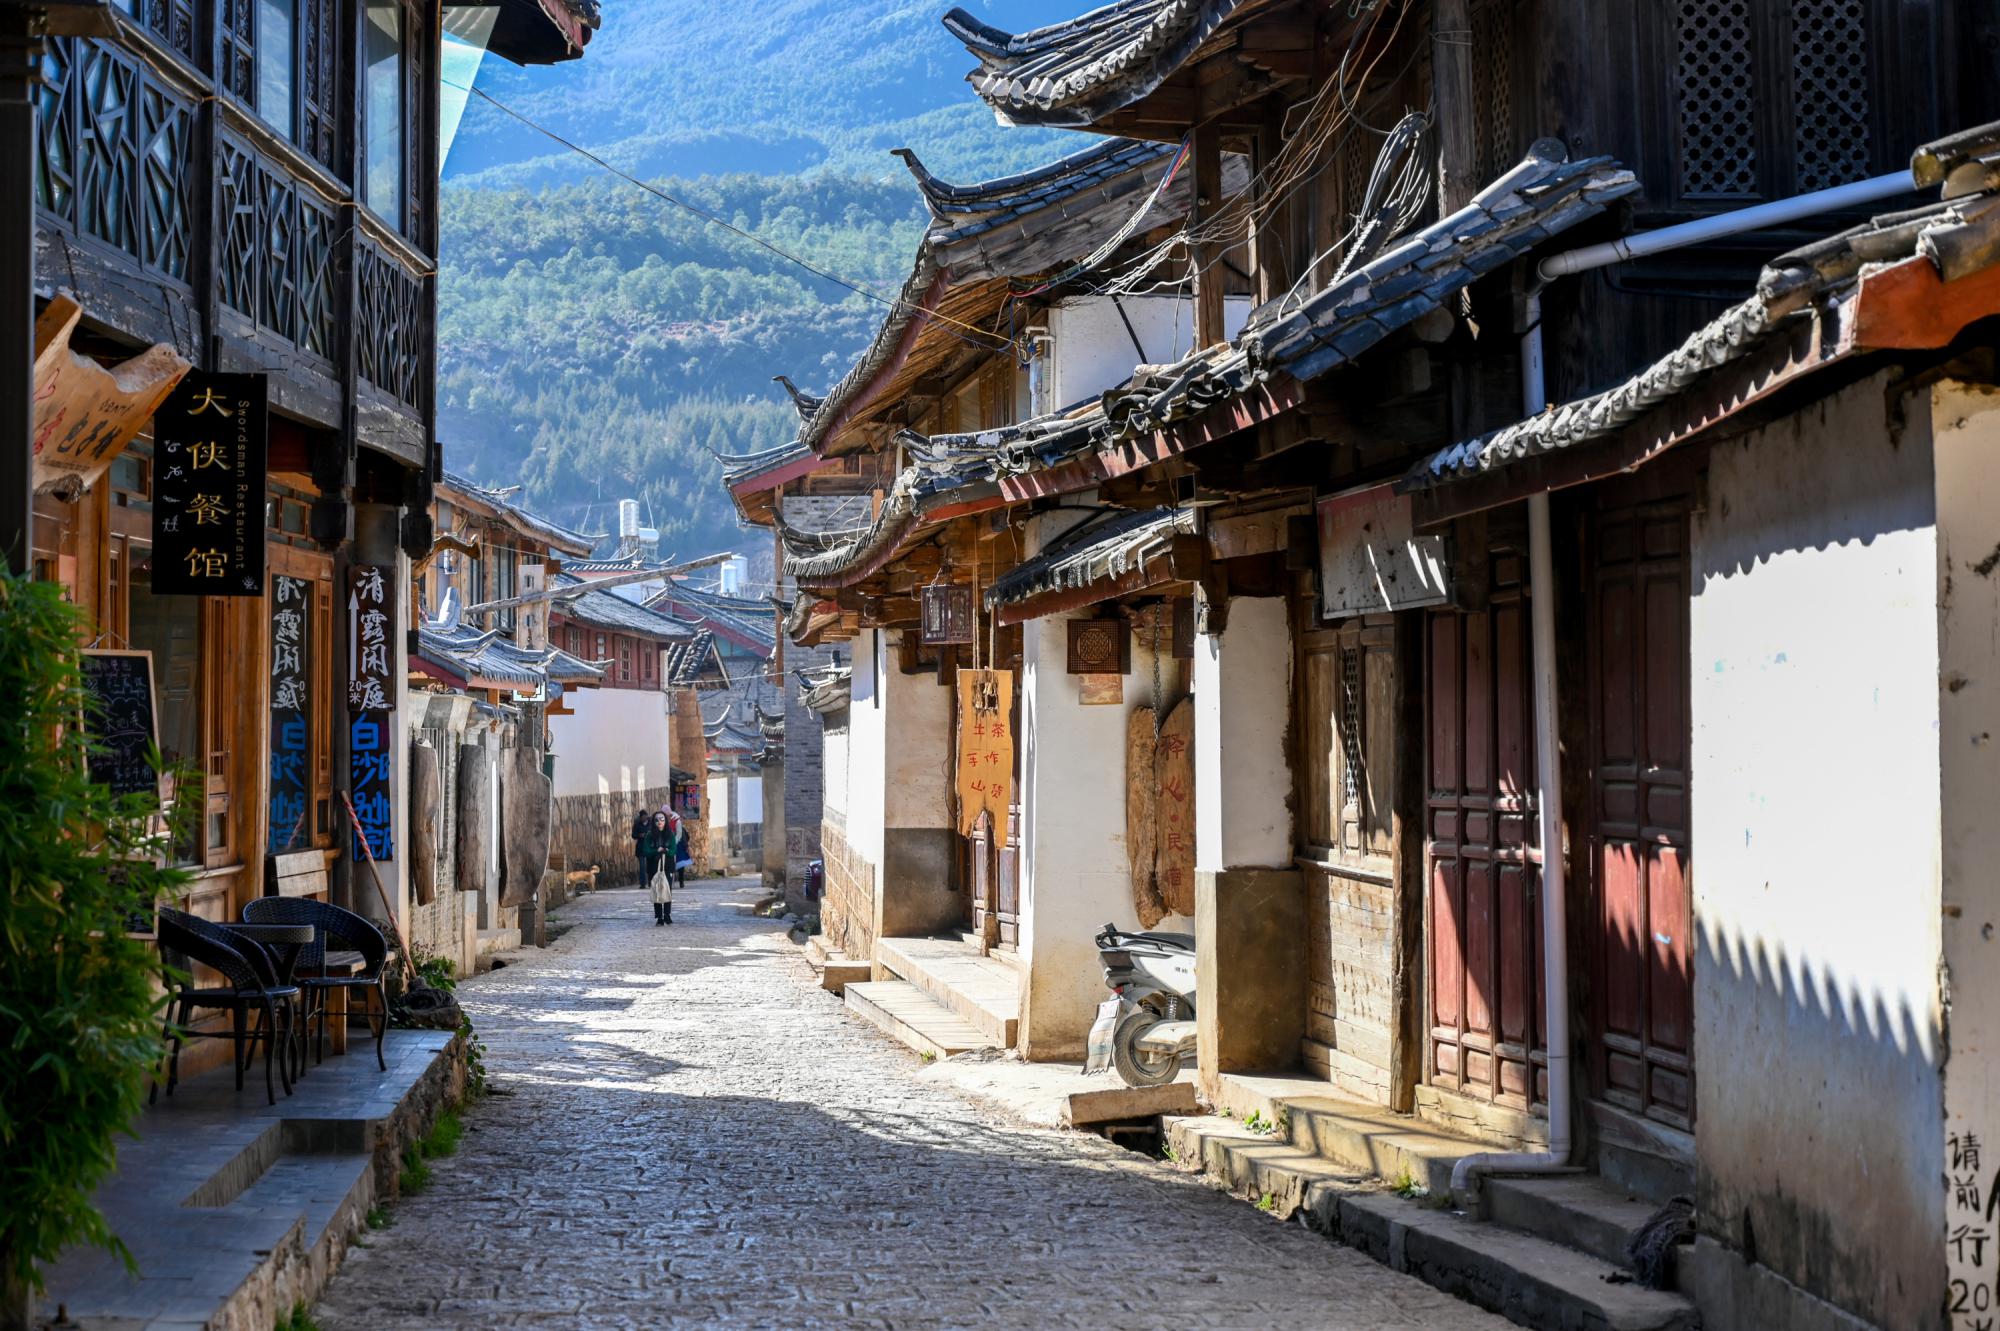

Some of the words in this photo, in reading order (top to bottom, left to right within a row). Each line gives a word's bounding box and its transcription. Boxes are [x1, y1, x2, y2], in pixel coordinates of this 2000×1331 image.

[237, 400, 250, 477] Swordsman
[184, 387, 234, 578] 大侠餐馆
[235, 483, 249, 569] Restaurant
